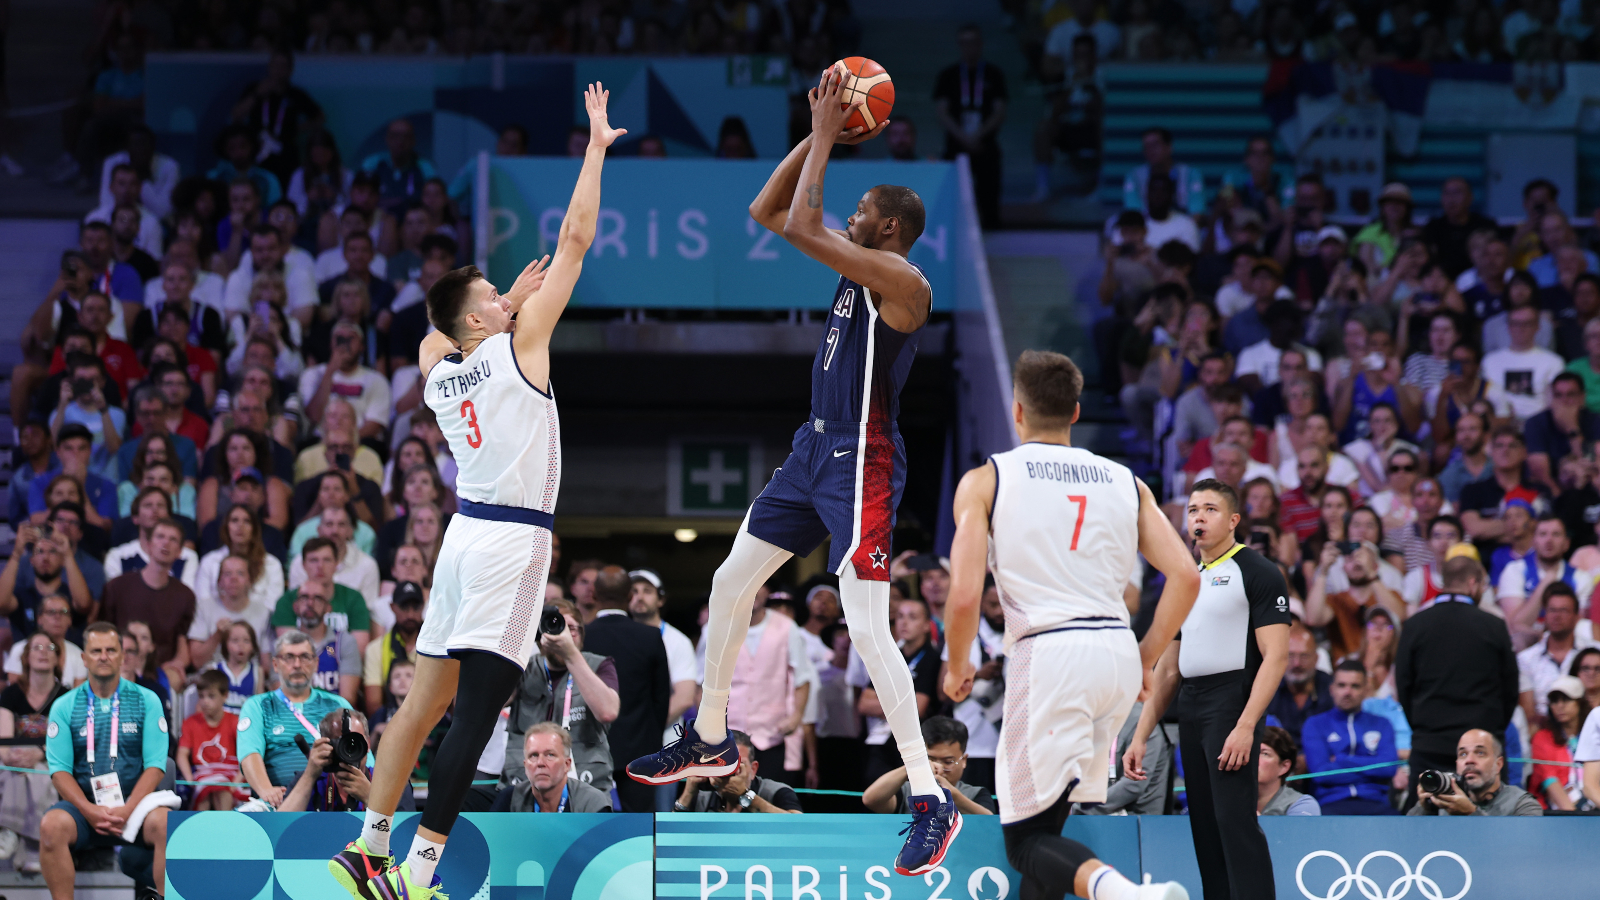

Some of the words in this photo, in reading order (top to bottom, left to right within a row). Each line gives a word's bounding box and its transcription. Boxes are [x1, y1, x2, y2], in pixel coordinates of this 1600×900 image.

[824, 327, 839, 371] 7
[460, 400, 482, 449] 3
[1066, 495, 1087, 551] 7
[417, 850, 438, 861] PEAK
